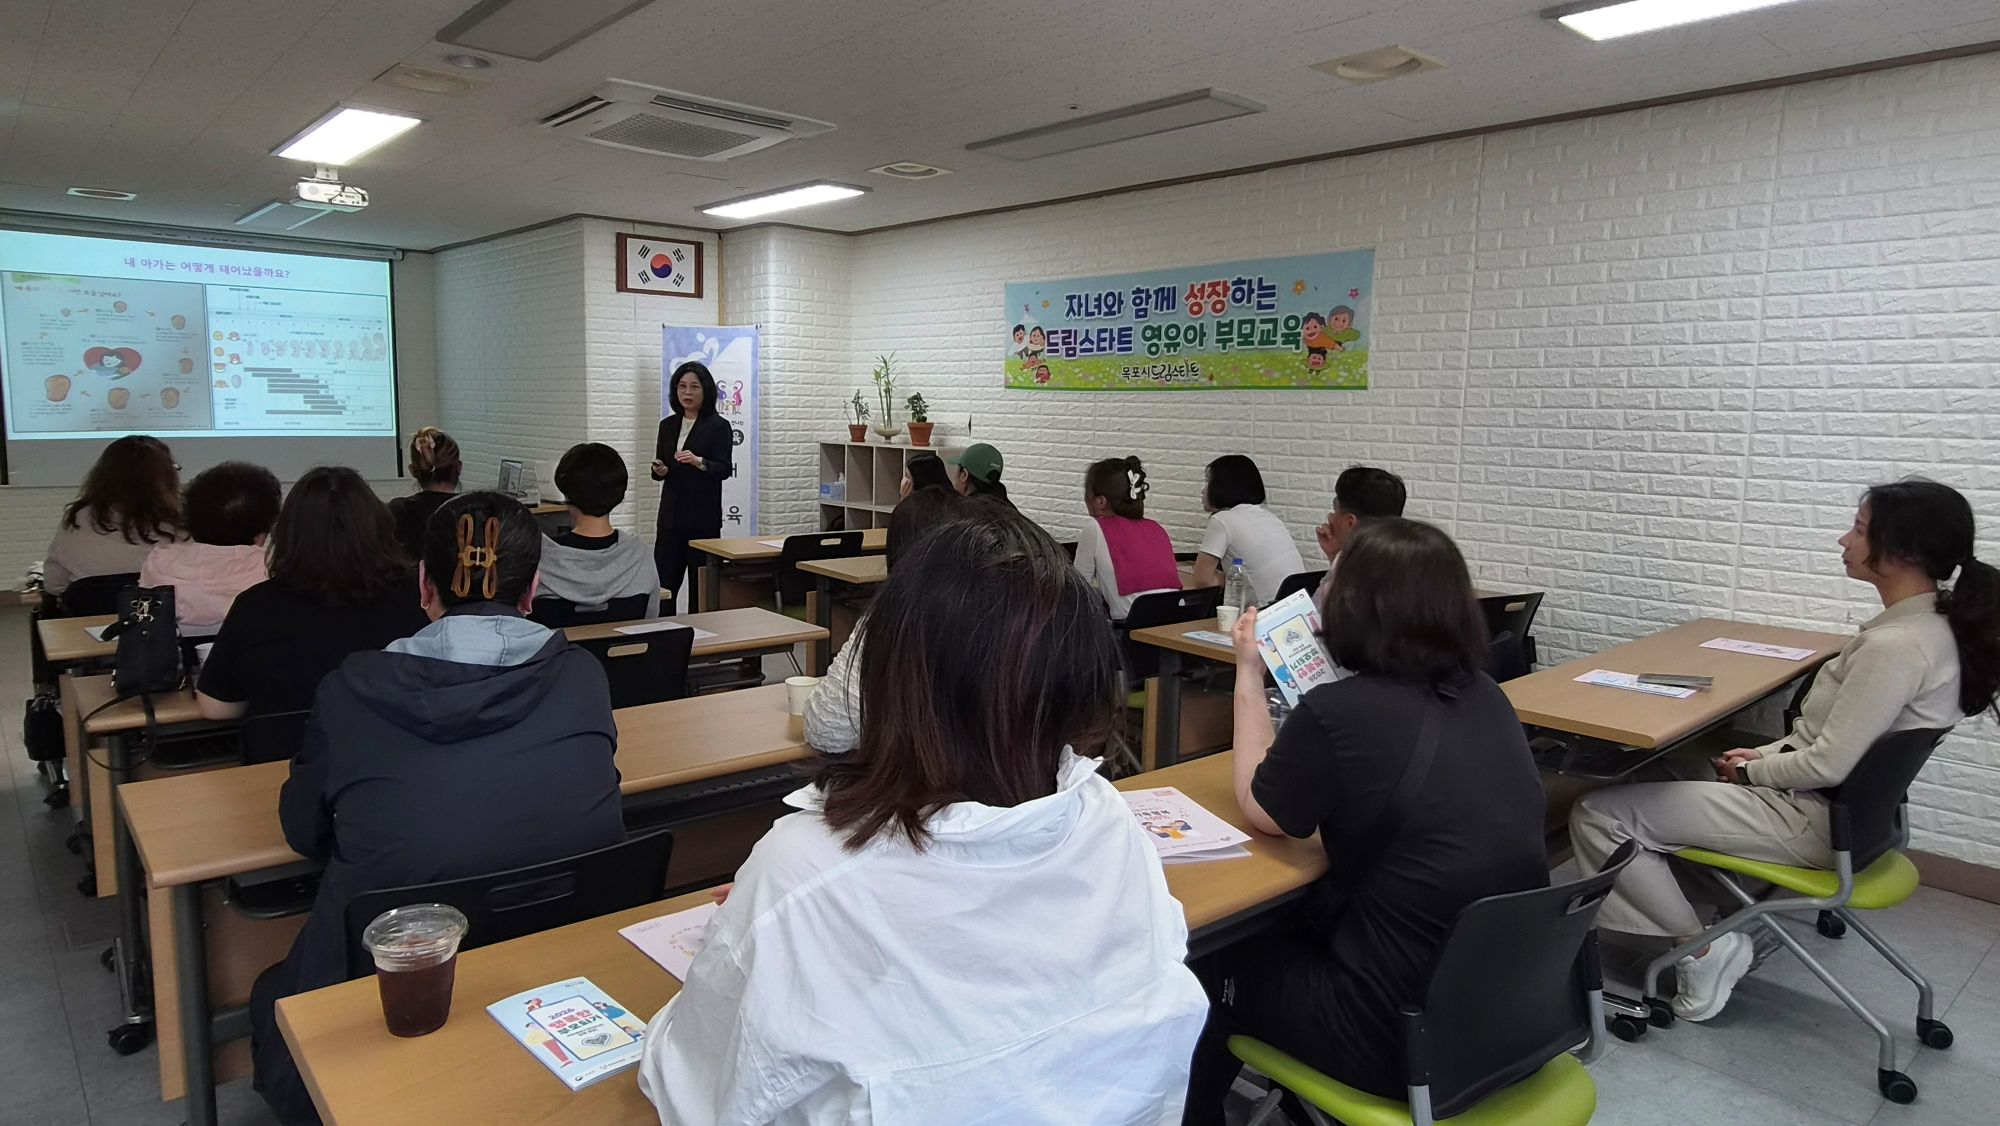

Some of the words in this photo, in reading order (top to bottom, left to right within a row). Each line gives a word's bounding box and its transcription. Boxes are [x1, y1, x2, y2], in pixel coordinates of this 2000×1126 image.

[124, 257, 136, 268] 내
[140, 258, 177, 271] 아가는
[180, 261, 215, 274] 어떻게
[219, 264, 291, 279] 태어났을까요?
[1064, 290, 1124, 319] 자녀와
[1131, 285, 1177, 320] 함께
[1183, 276, 1277, 317] 성장하는
[1045, 325, 1134, 358] 드림스타트
[1141, 322, 1207, 357] 영유아
[1214, 314, 1302, 351] 부모교육
[1308, 668, 1326, 682] 2026
[548, 1008, 575, 1020] 2026
